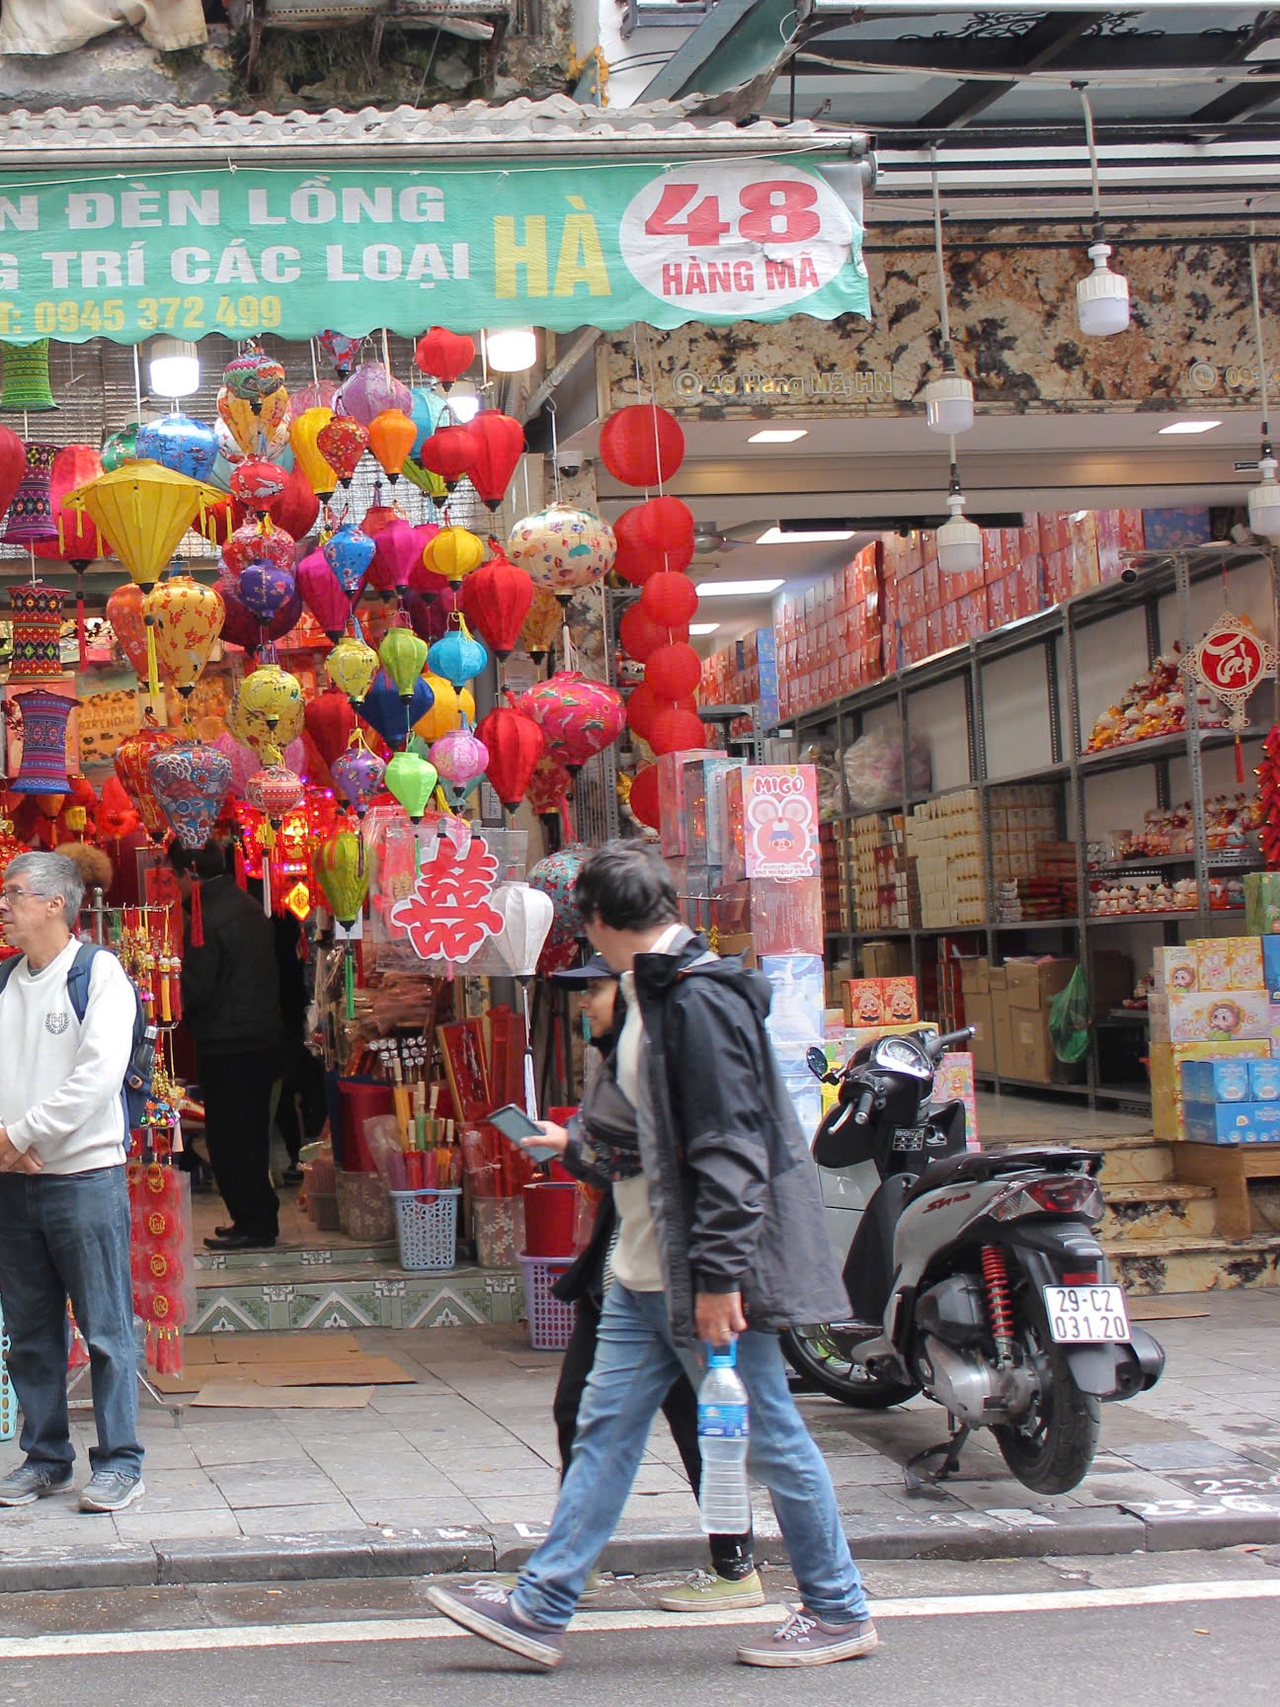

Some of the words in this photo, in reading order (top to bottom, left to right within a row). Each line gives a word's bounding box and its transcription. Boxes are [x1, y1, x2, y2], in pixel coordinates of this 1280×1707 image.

[64, 183, 220, 229] ĐÈN
[248, 175, 445, 225] LỒNG
[644, 180, 820, 246] 48
[41, 240, 148, 288] TRÍ
[170, 238, 301, 284] CÁC
[326, 242, 470, 289] LOẠI
[493, 195, 613, 298] HÀ
[662, 256, 755, 296] HÀNG
[766, 251, 820, 290] MÃ
[34, 299, 126, 333] 0945
[137, 297, 206, 329] 372
[216, 295, 282, 328] 499
[706, 374, 736, 394] 46
[743, 373, 804, 398] Hàng
[855, 371, 893, 394] HN
[754, 776, 805, 795] MIGO
[1056, 1289, 1114, 1313] 29-C2
[1054, 1315, 1126, 1339] 031.20
